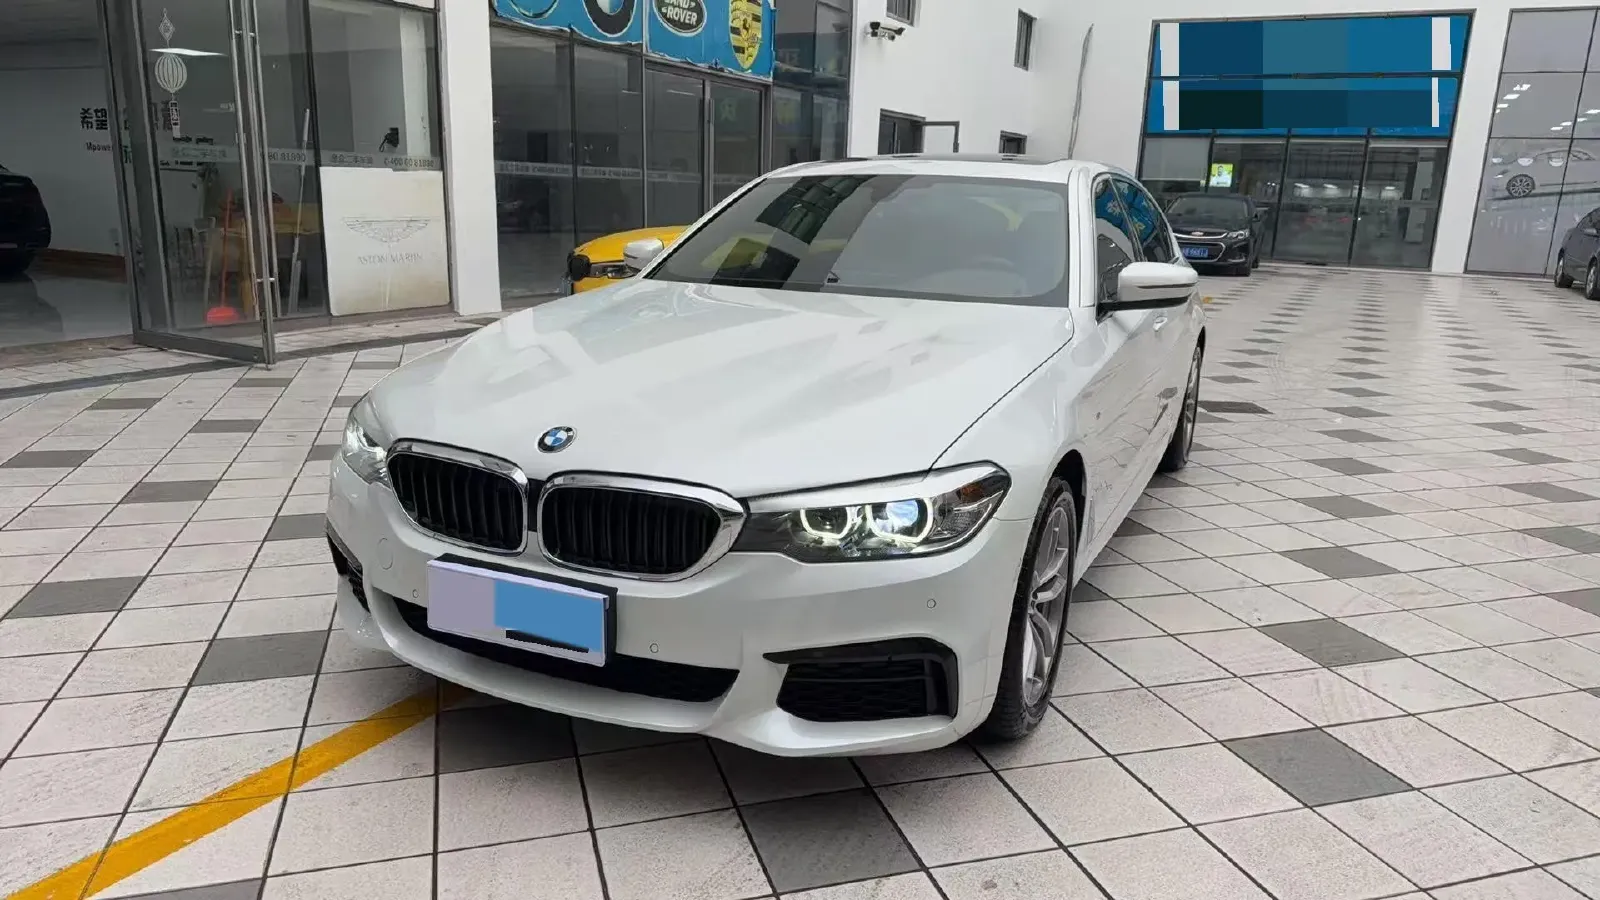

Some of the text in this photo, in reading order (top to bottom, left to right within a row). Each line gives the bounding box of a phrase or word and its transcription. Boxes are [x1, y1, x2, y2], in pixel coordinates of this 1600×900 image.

[667, 6, 698, 25] ROVER
[79, 107, 108, 130] 希望
[358, 253, 388, 265] ASTON
